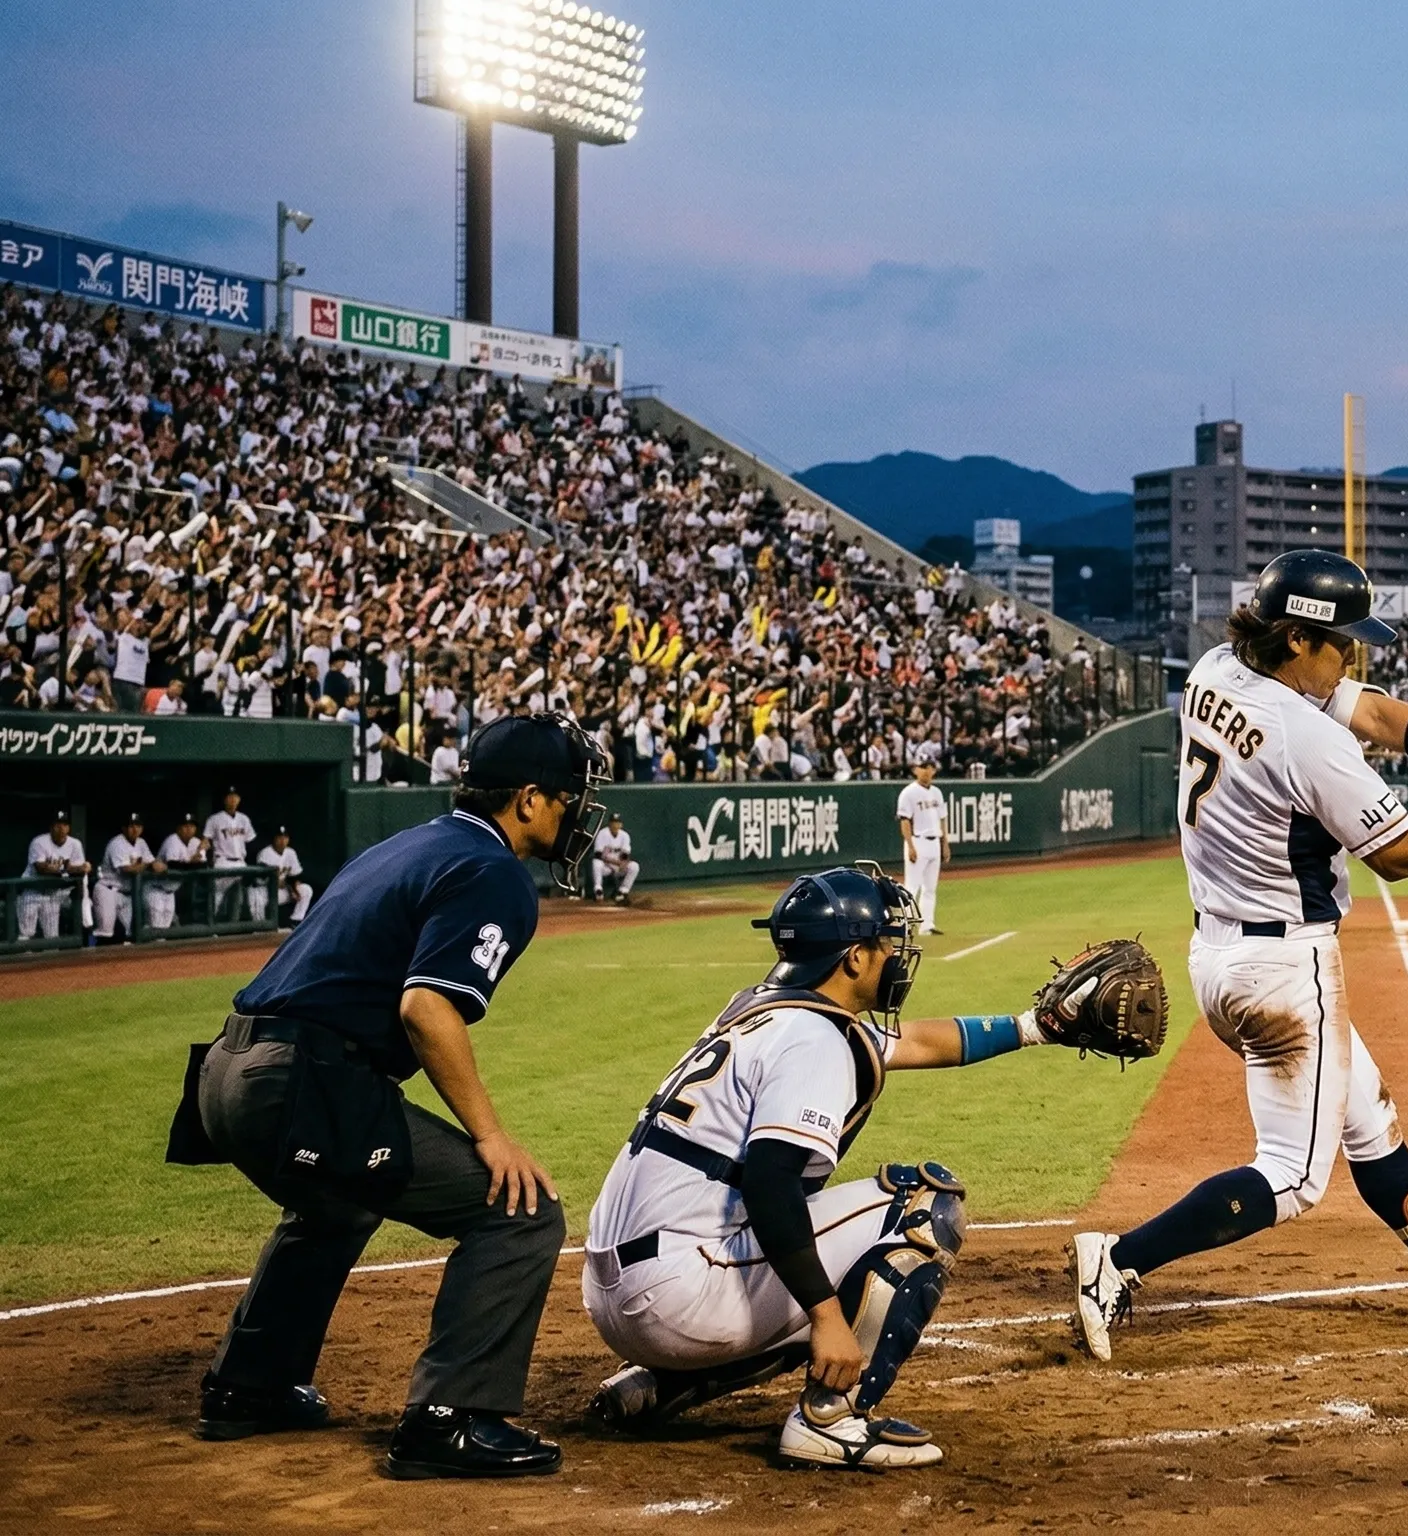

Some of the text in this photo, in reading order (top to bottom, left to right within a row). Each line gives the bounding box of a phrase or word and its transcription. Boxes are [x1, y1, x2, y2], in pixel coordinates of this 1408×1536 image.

[122, 256, 249, 323] 関門海峡
[350, 312, 441, 353] 山口銀行
[1182, 682, 1264, 761] TIGERS
[1184, 736, 1222, 830] 7
[739, 794, 839, 859] 関門海峡
[944, 792, 1012, 844] 山口銀行
